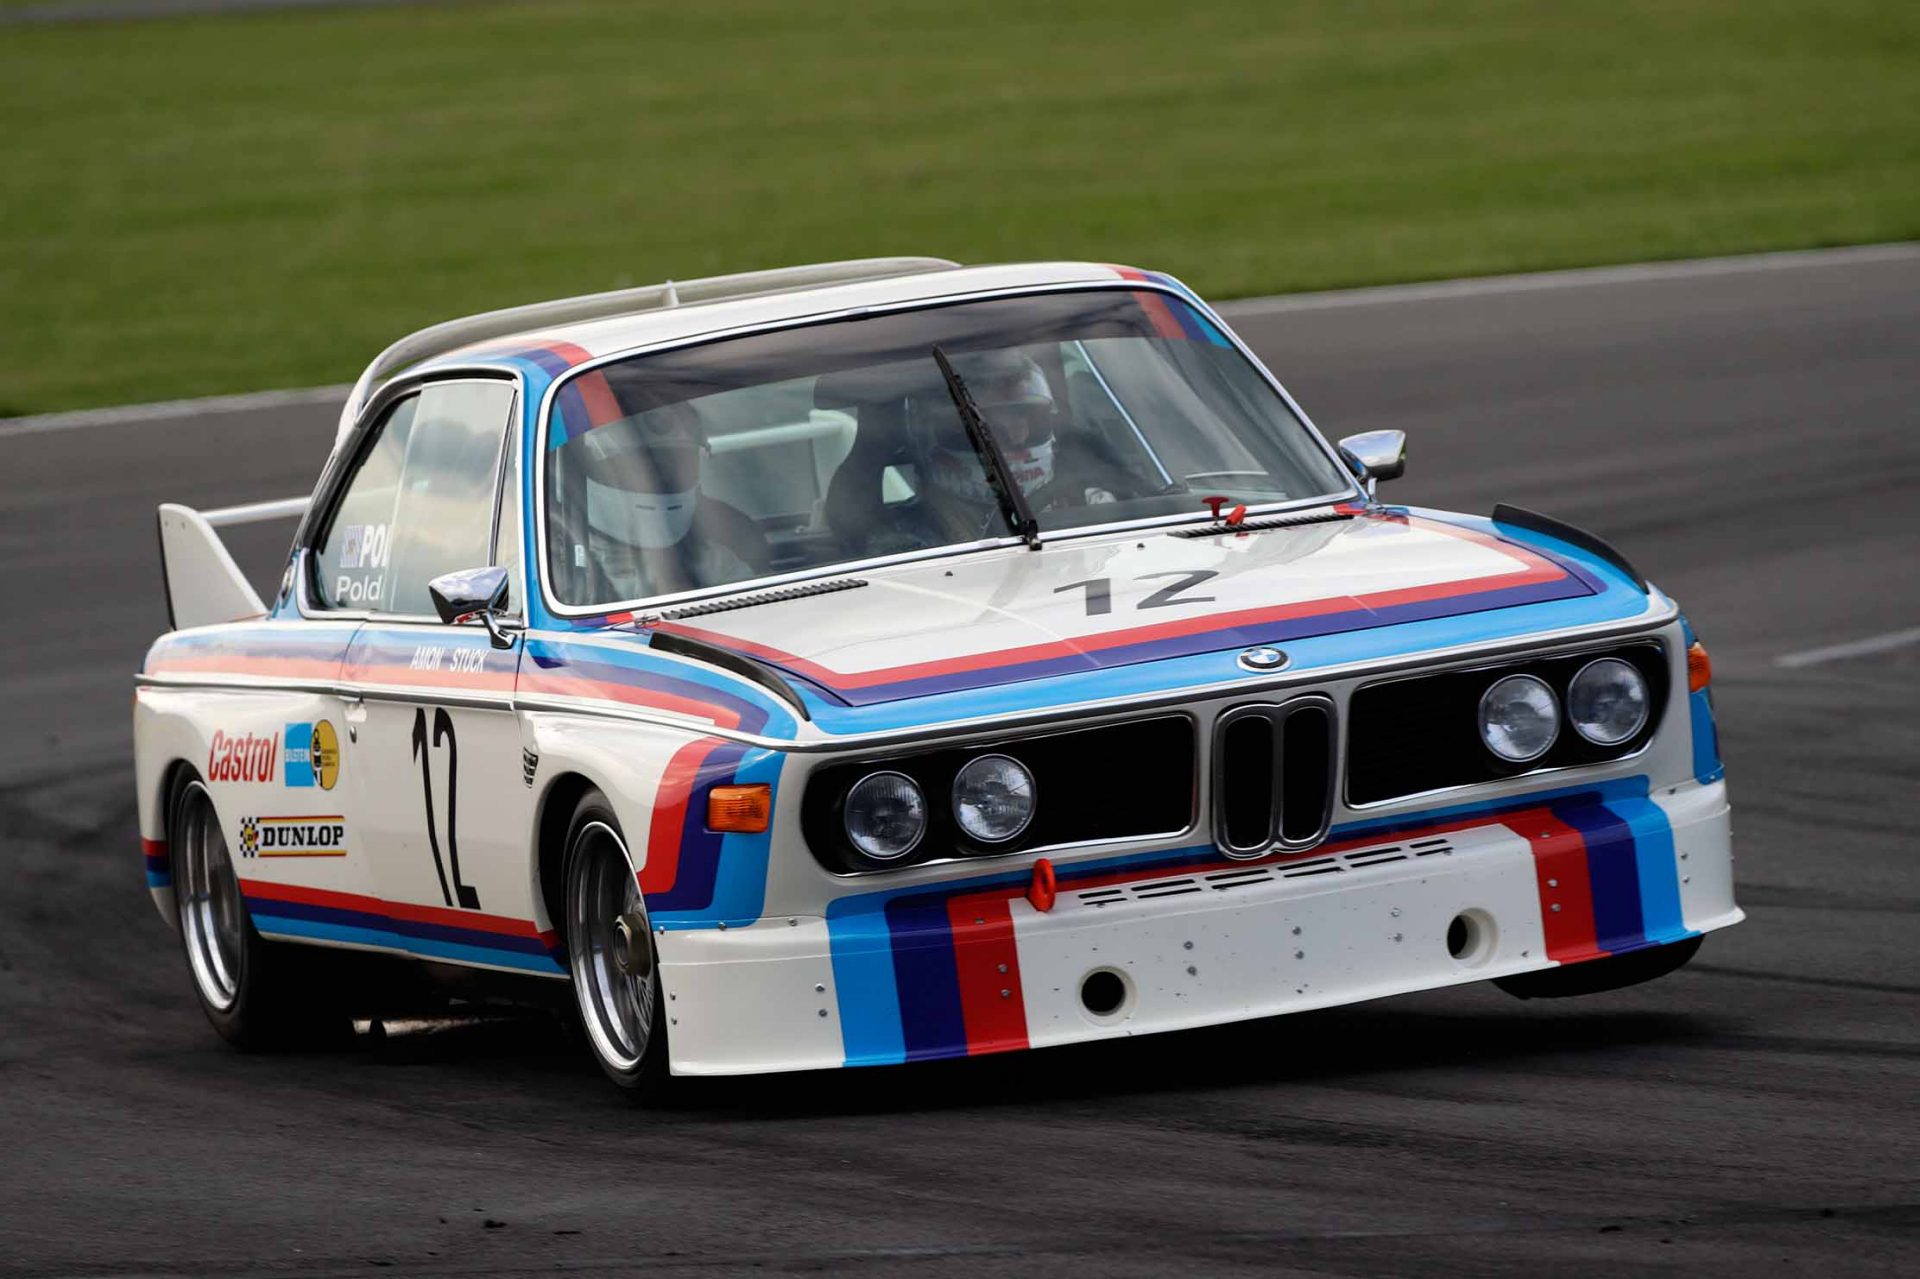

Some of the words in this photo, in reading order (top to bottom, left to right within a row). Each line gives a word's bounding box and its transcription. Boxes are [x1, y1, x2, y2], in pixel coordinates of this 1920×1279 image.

[1053, 569, 1220, 616] 12
[449, 647, 489, 673] STUCK
[208, 729, 279, 782] Castrol
[412, 706, 481, 910] 12
[262, 825, 344, 847] DUNLOP
